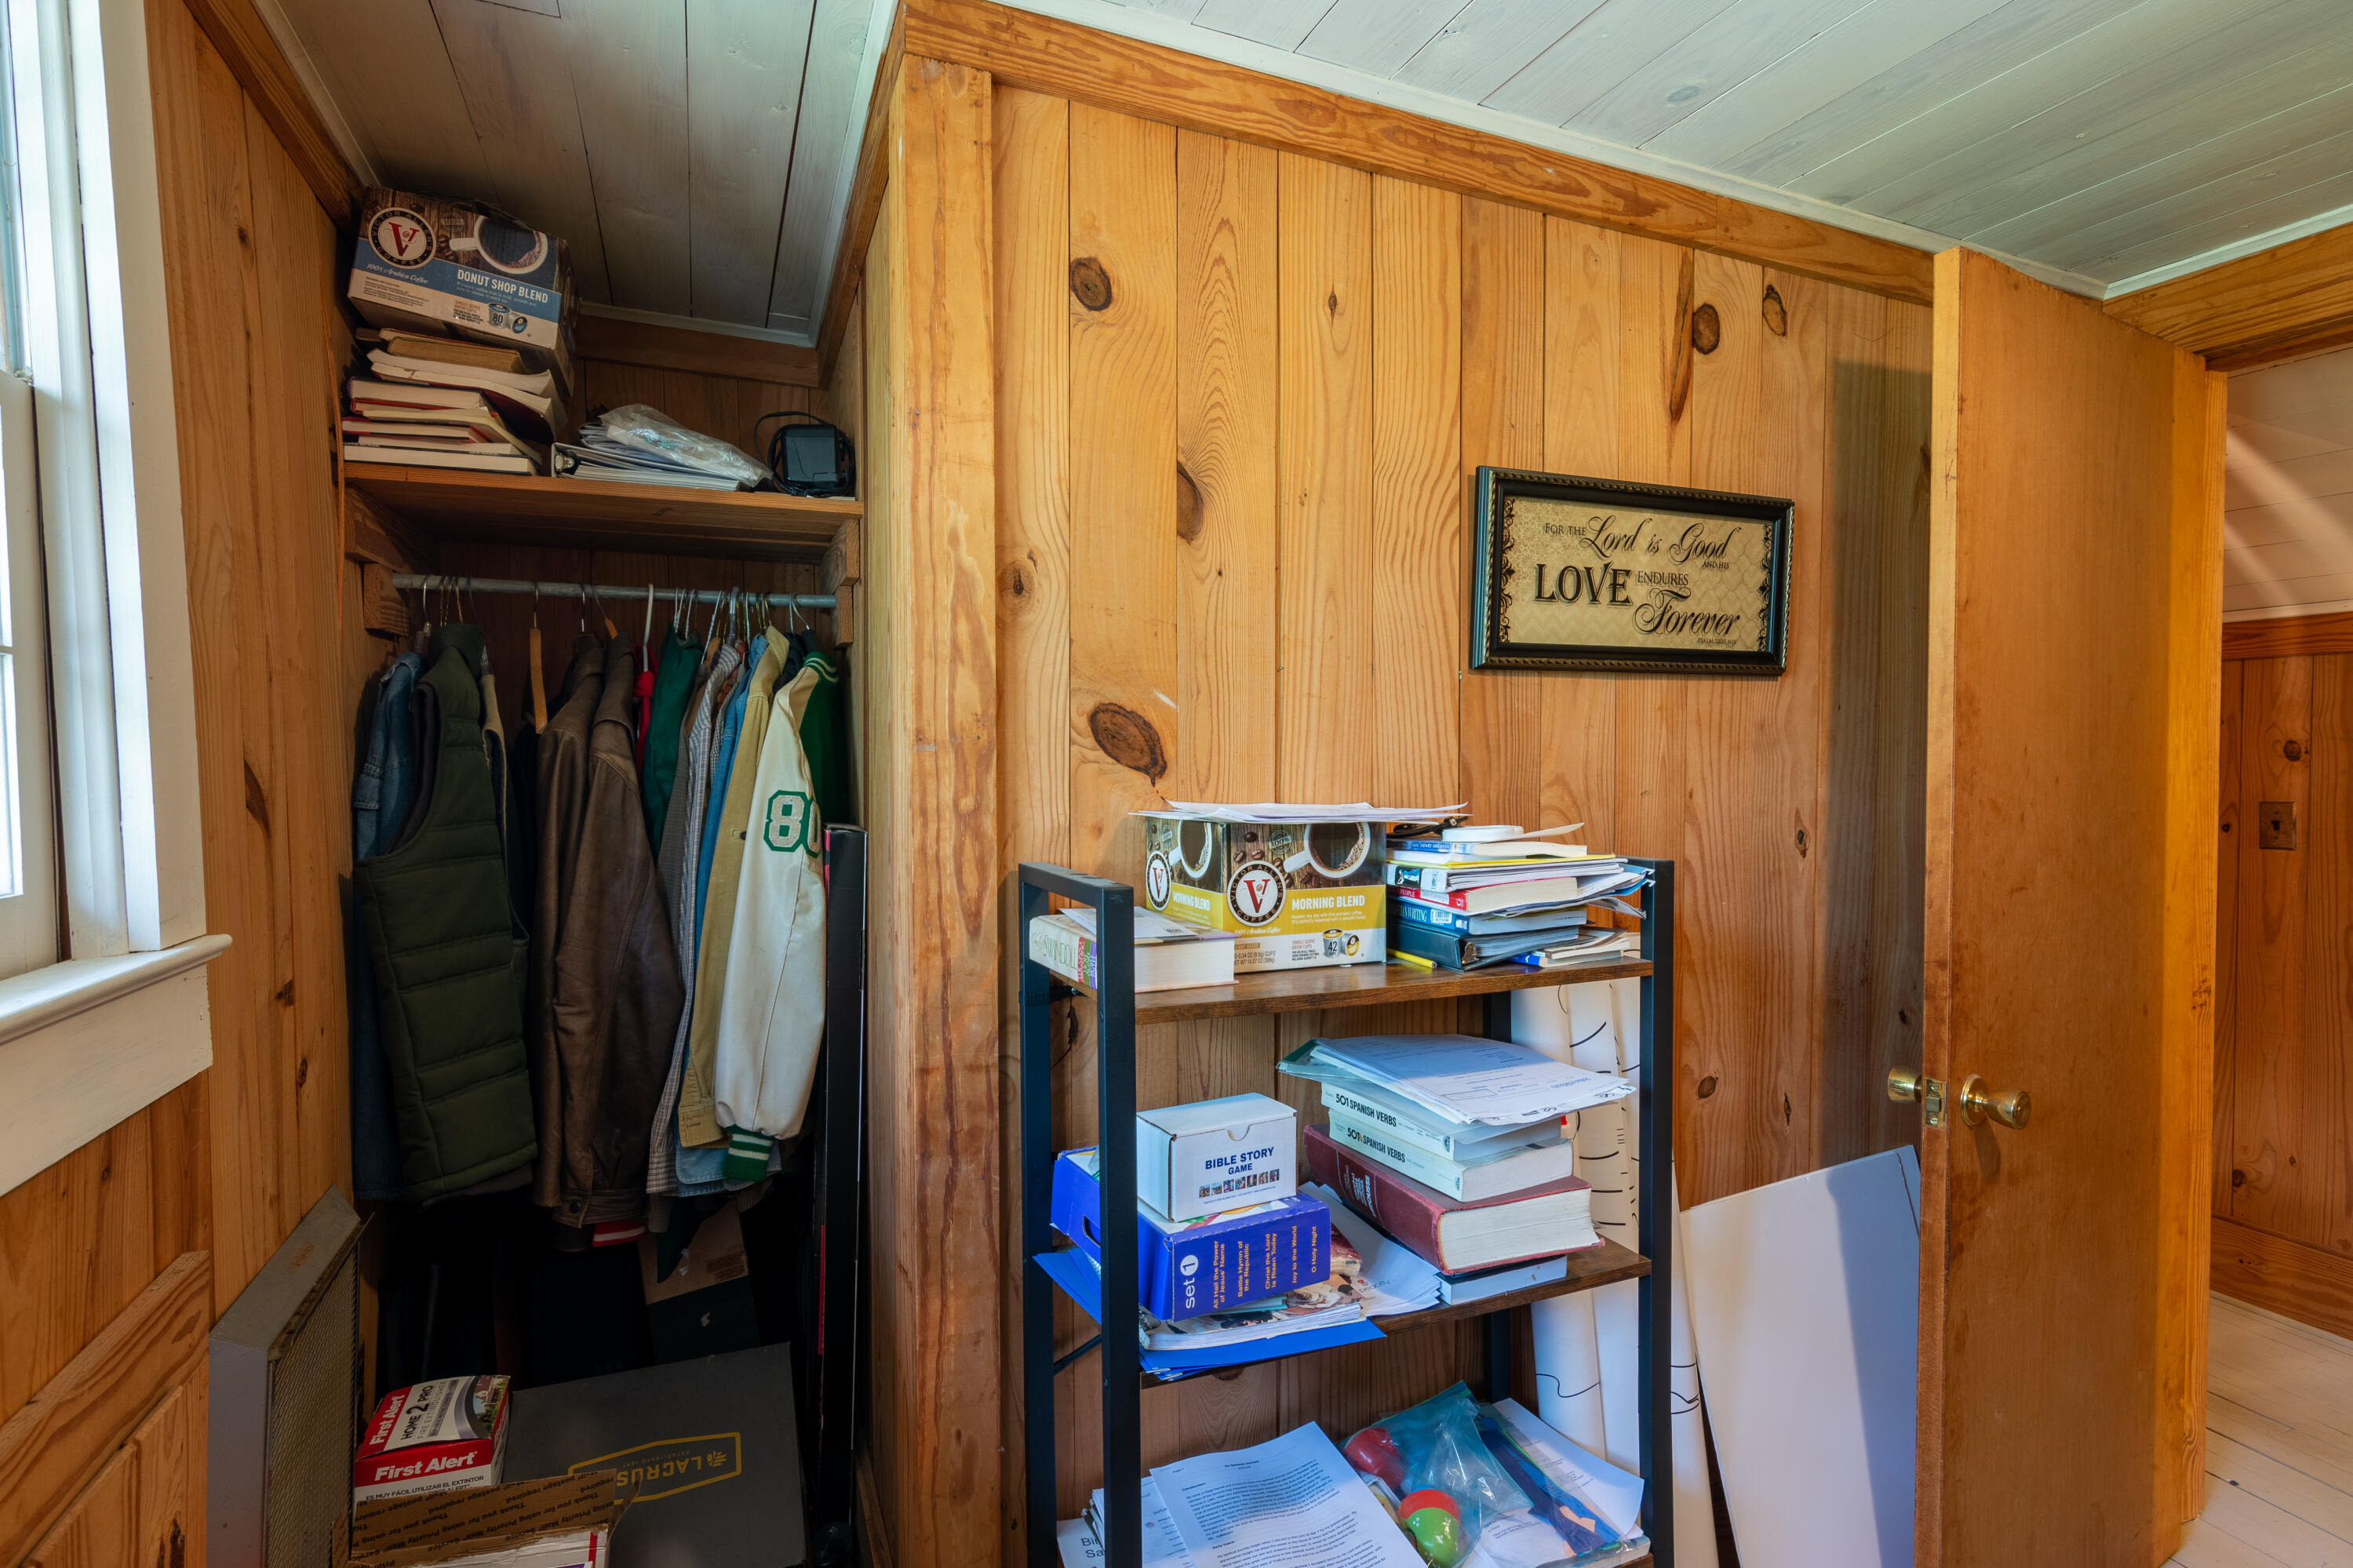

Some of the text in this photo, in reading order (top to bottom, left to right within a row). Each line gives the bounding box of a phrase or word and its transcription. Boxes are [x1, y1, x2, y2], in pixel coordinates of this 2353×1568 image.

[372, 210, 401, 236] VICTOR
[377, 246, 424, 266] COFFEE
[384, 268, 410, 279] Arabica
[410, 275, 429, 284] Coffee
[457, 269, 548, 304] DONUT SHOP BLEND
[493, 313, 504, 324] 80
[1545, 515, 1742, 563] FOR THE Lord is Good
[1703, 560, 1717, 569] AND
[1534, 561, 1689, 606] LOVE ENDURES
[1634, 588, 1741, 635] Forever
[1230, 865, 1284, 901] VICTOR ALLEN'S
[1173, 891, 1211, 911] MORNING BLEND
[1400, 889, 1415, 898] PEOPLE
[1291, 894, 1365, 911] MORNING BLEND
[1237, 908, 1277, 922] COFFEE
[1408, 906, 1427, 922] WRITING
[1266, 926, 1281, 934] Coffee
[1328, 940, 1338, 952] 42
[1335, 1093, 1349, 1107] 501
[1350, 1100, 1375, 1119] SPANISH
[1376, 1110, 1397, 1127] VERBS
[1347, 1127, 1361, 1141] 501
[1363, 1135, 1386, 1154] SPANISH
[1387, 1146, 1406, 1163] VERBS
[1205, 1147, 1274, 1170] BIBLE STORY
[1228, 1163, 1253, 1175] GAME
[1237, 1241, 1243, 1250] of
[1291, 1262, 1297, 1271] to
[1182, 1262, 1196, 1309] set 1
[1220, 1294, 1225, 1303] of
[400, 1385, 434, 1440] HOME 2 PRO
[417, 1380, 446, 1439] FIRE EXTINGUISHER
[369, 1394, 406, 1446] First Alert
[375, 1461, 423, 1482] First
[392, 1487, 411, 1497] FÁCIL
[412, 1483, 442, 1493] UTILIZAR
[451, 1475, 484, 1486] EXTINTOR
[543, 1475, 576, 1490] postage
[581, 1477, 614, 1493] required
[467, 1486, 501, 1501] postage
[506, 1487, 541, 1504] required
[574, 1492, 599, 1504] Thank
[388, 1496, 423, 1512] postage
[428, 1498, 465, 1515] required
[544, 1506, 555, 1515] for
[557, 1501, 572, 1510] you
[593, 1501, 614, 1513] using
[408, 1502, 525, 1544] Thank you for using Priority
[422, 1512, 449, 1525] Thank
[519, 1510, 541, 1522] using
[562, 1509, 591, 1523] Priority
[403, 1520, 420, 1530] you
[486, 1519, 517, 1533] Priority
[361, 1532, 386, 1544] using
